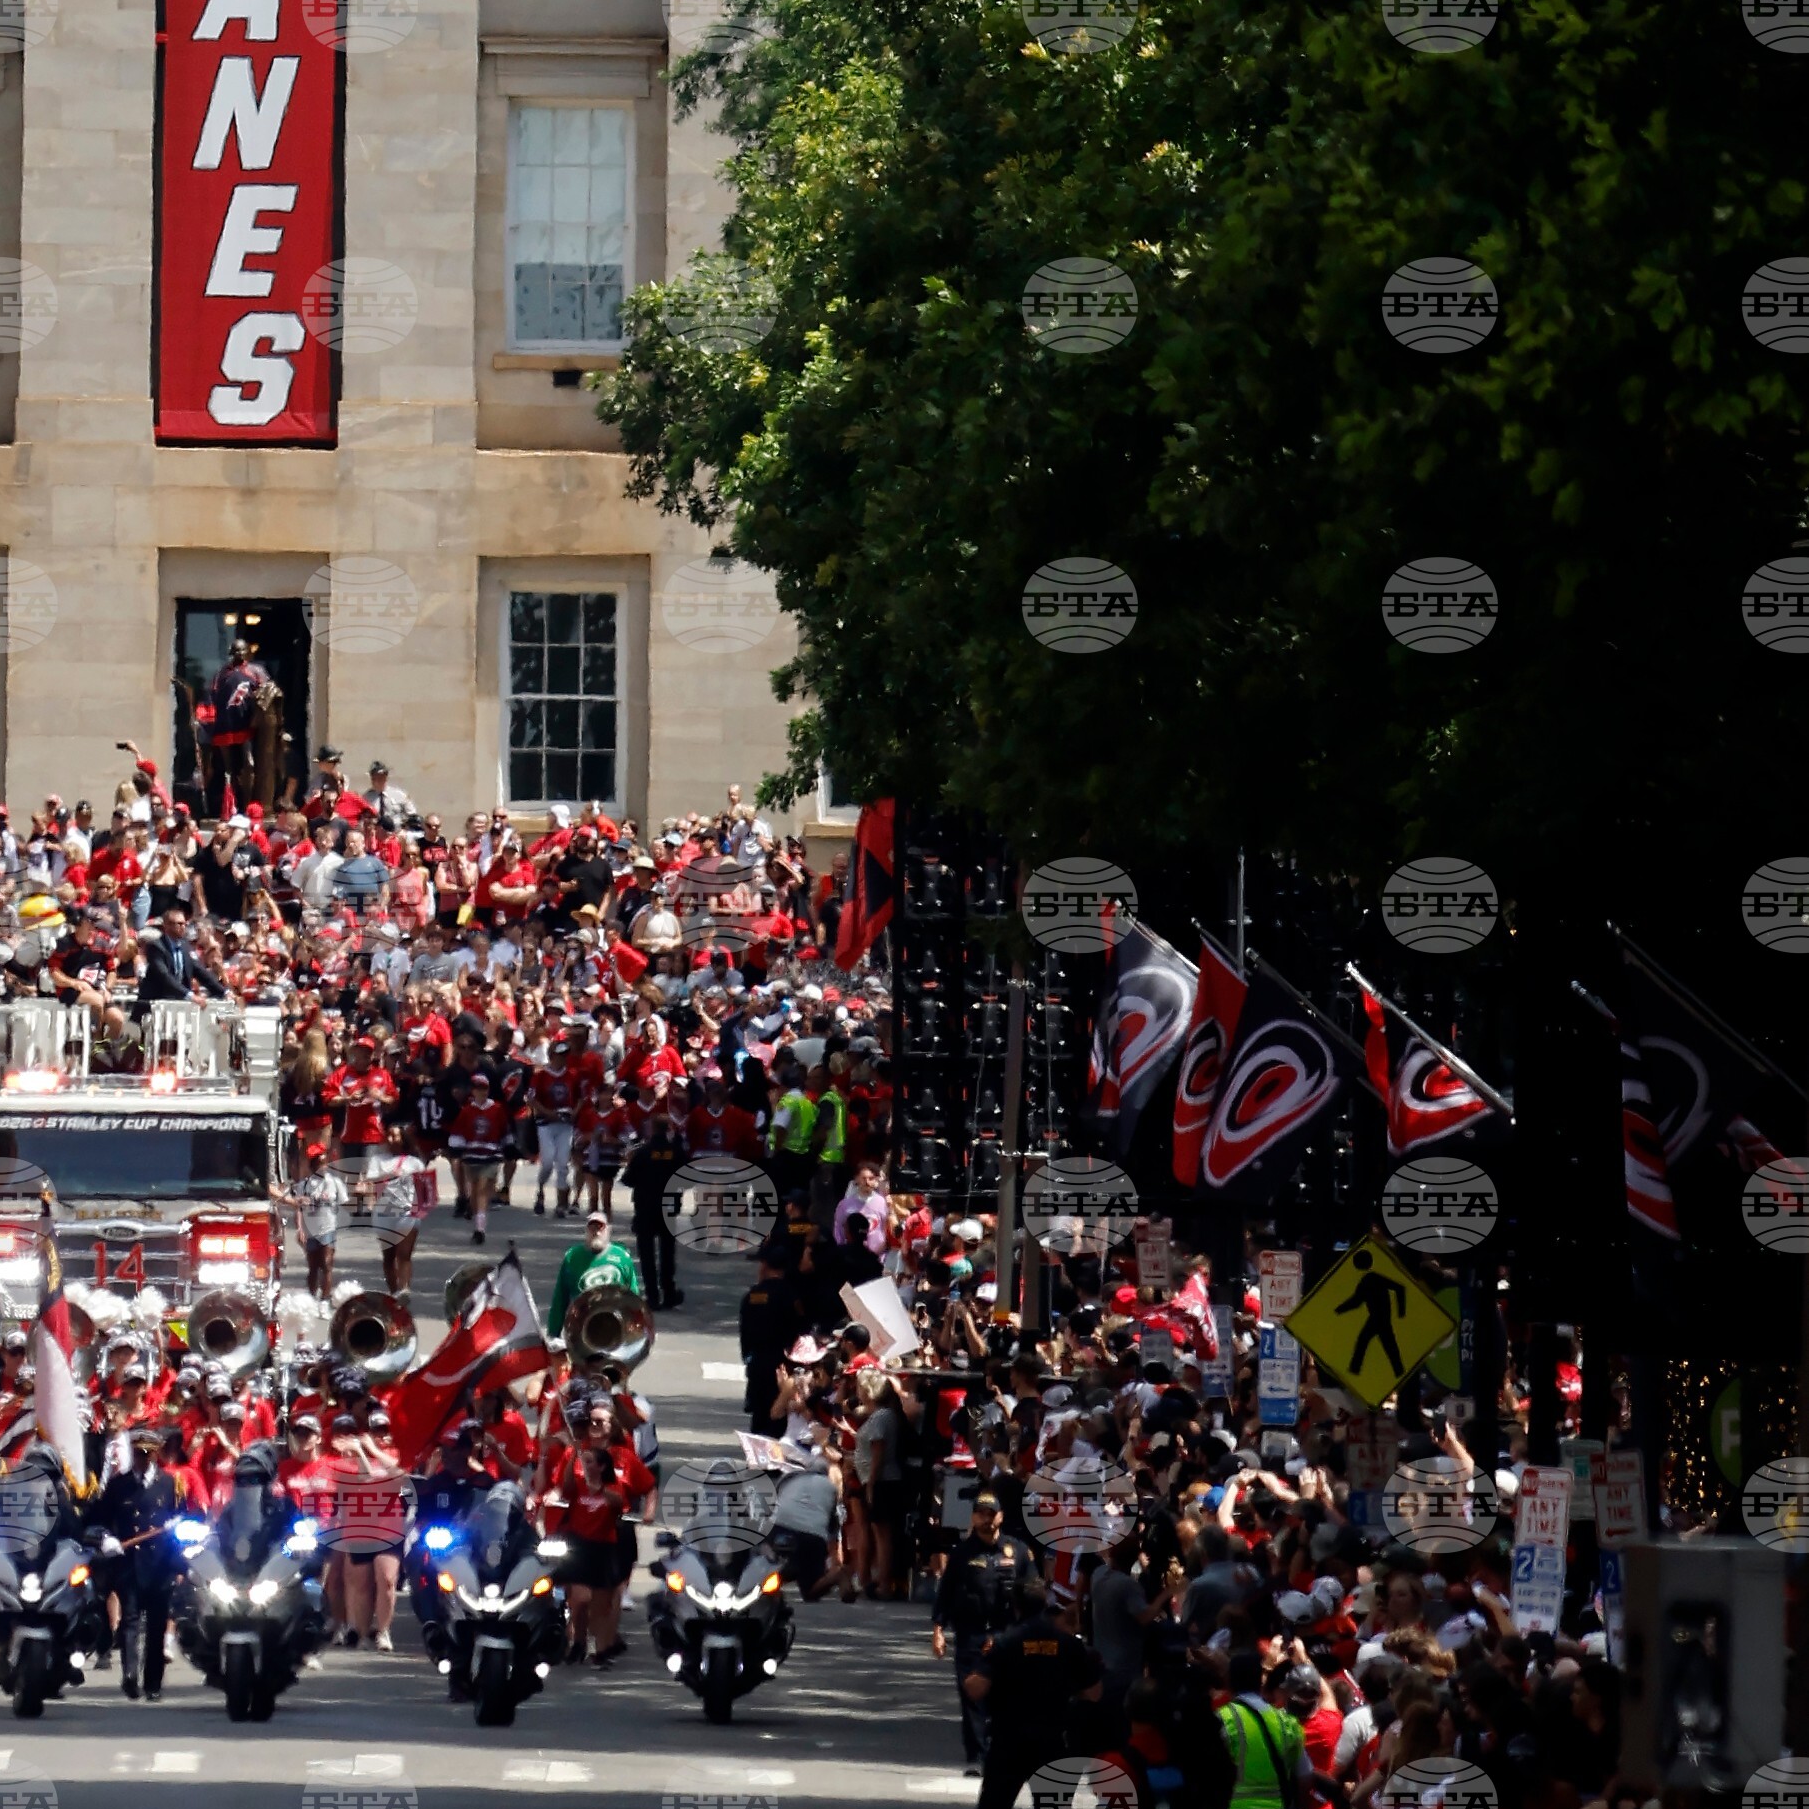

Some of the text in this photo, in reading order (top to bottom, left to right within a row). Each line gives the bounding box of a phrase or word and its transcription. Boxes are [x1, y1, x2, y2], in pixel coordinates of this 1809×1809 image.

[46, 1116, 123, 1131] STANLEY
[123, 1116, 159, 1131] CUP
[160, 1116, 253, 1132] CHAMPIONS
[93, 1241, 146, 1292] 14
[1530, 1499, 1560, 1514] ANY
[1526, 1518, 1559, 1534] TIME
[1516, 1550, 1533, 1579] 2
